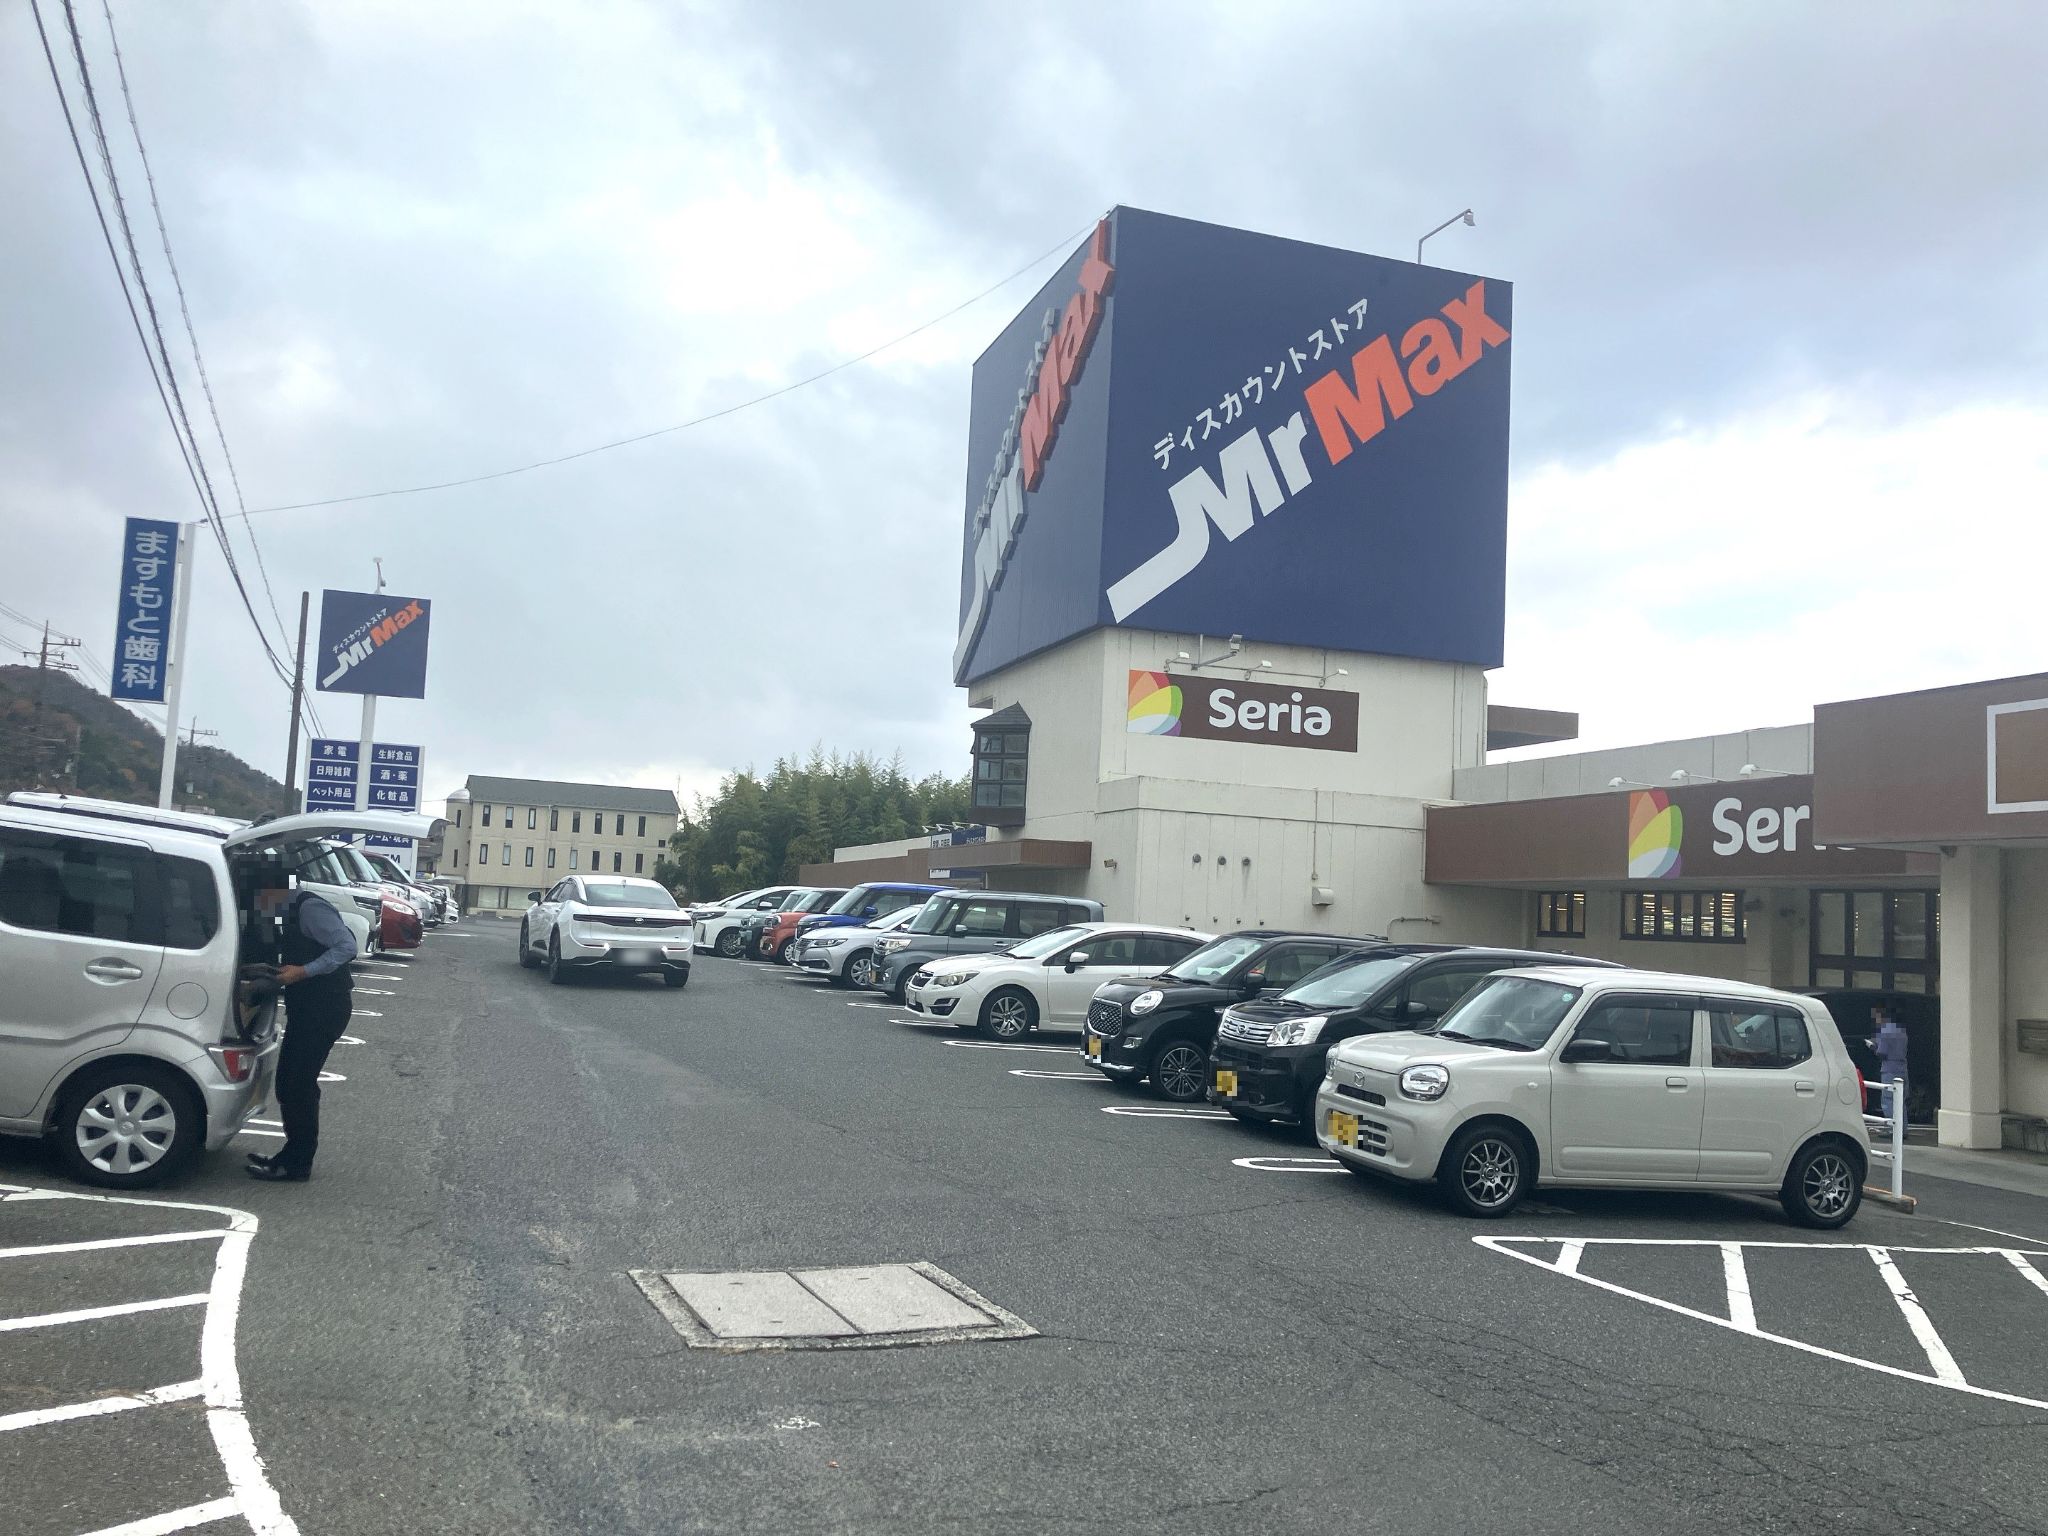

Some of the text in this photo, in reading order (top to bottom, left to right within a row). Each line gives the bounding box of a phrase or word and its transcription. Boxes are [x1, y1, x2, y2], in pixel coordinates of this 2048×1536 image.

[1154, 298, 1368, 469] ディスカウントストア
[1106, 280, 1511, 623] MrMax
[121, 531, 169, 690] ますもと歯科
[332, 607, 388, 654] ディスカウントストア
[322, 600, 424, 688] MrMax
[1208, 688, 1332, 736] Seria
[316, 765, 352, 778] 日用雑貨
[378, 749, 413, 762] 生鮮食品
[312, 787, 352, 798] ペット用品
[1712, 797, 1857, 856] Ser
